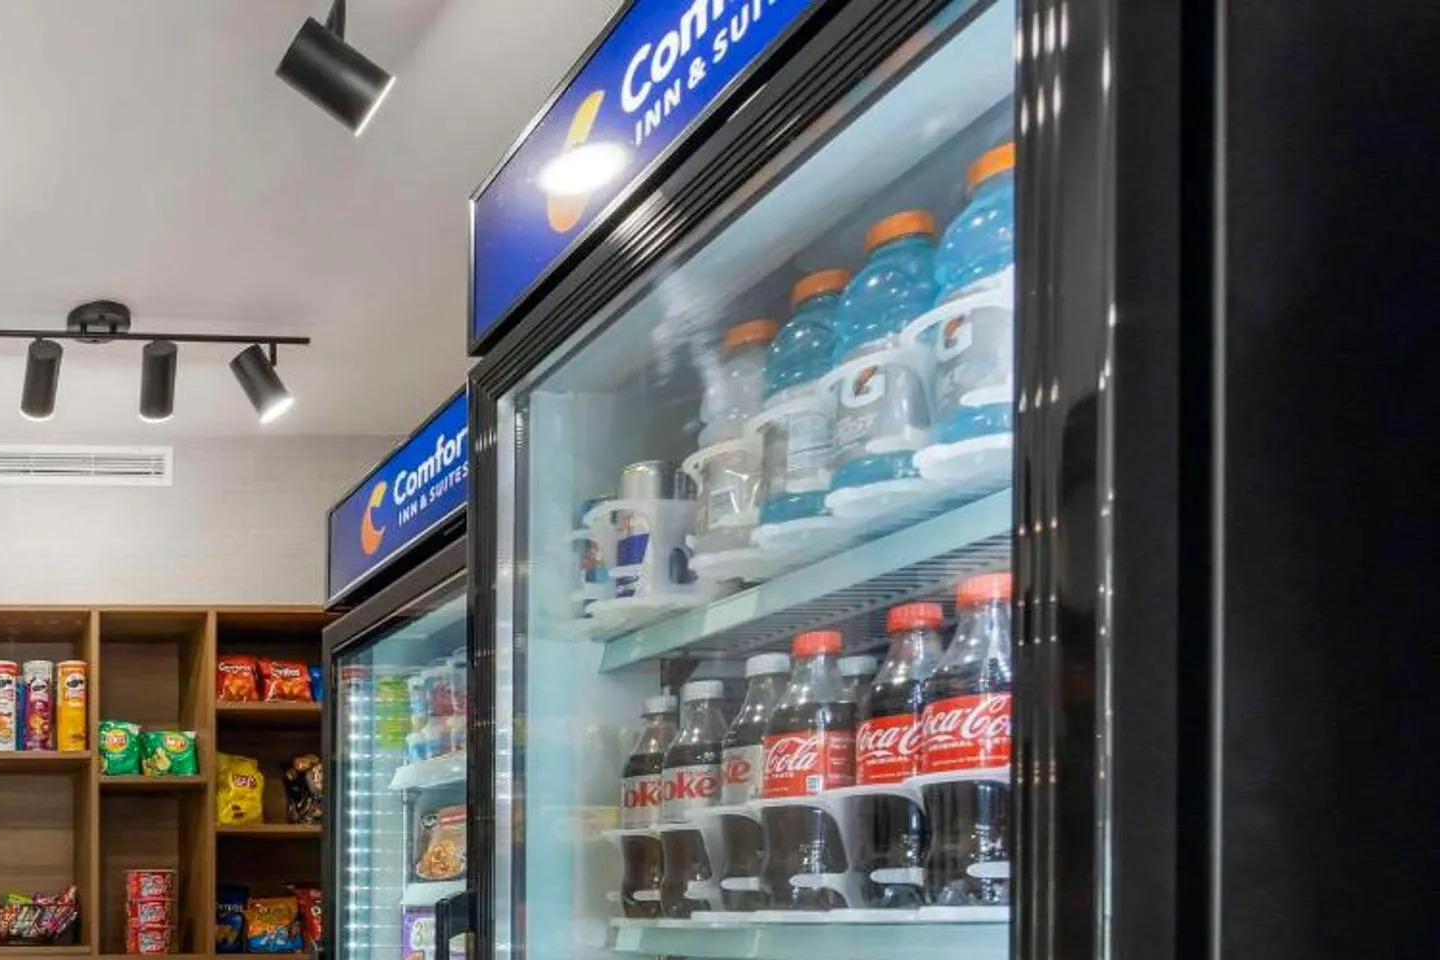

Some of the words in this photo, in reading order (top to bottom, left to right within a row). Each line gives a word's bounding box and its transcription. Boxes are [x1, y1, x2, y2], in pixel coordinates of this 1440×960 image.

[634, 78, 681, 147] INN
[687, 56, 708, 91] &
[398, 500, 418, 528] INN
